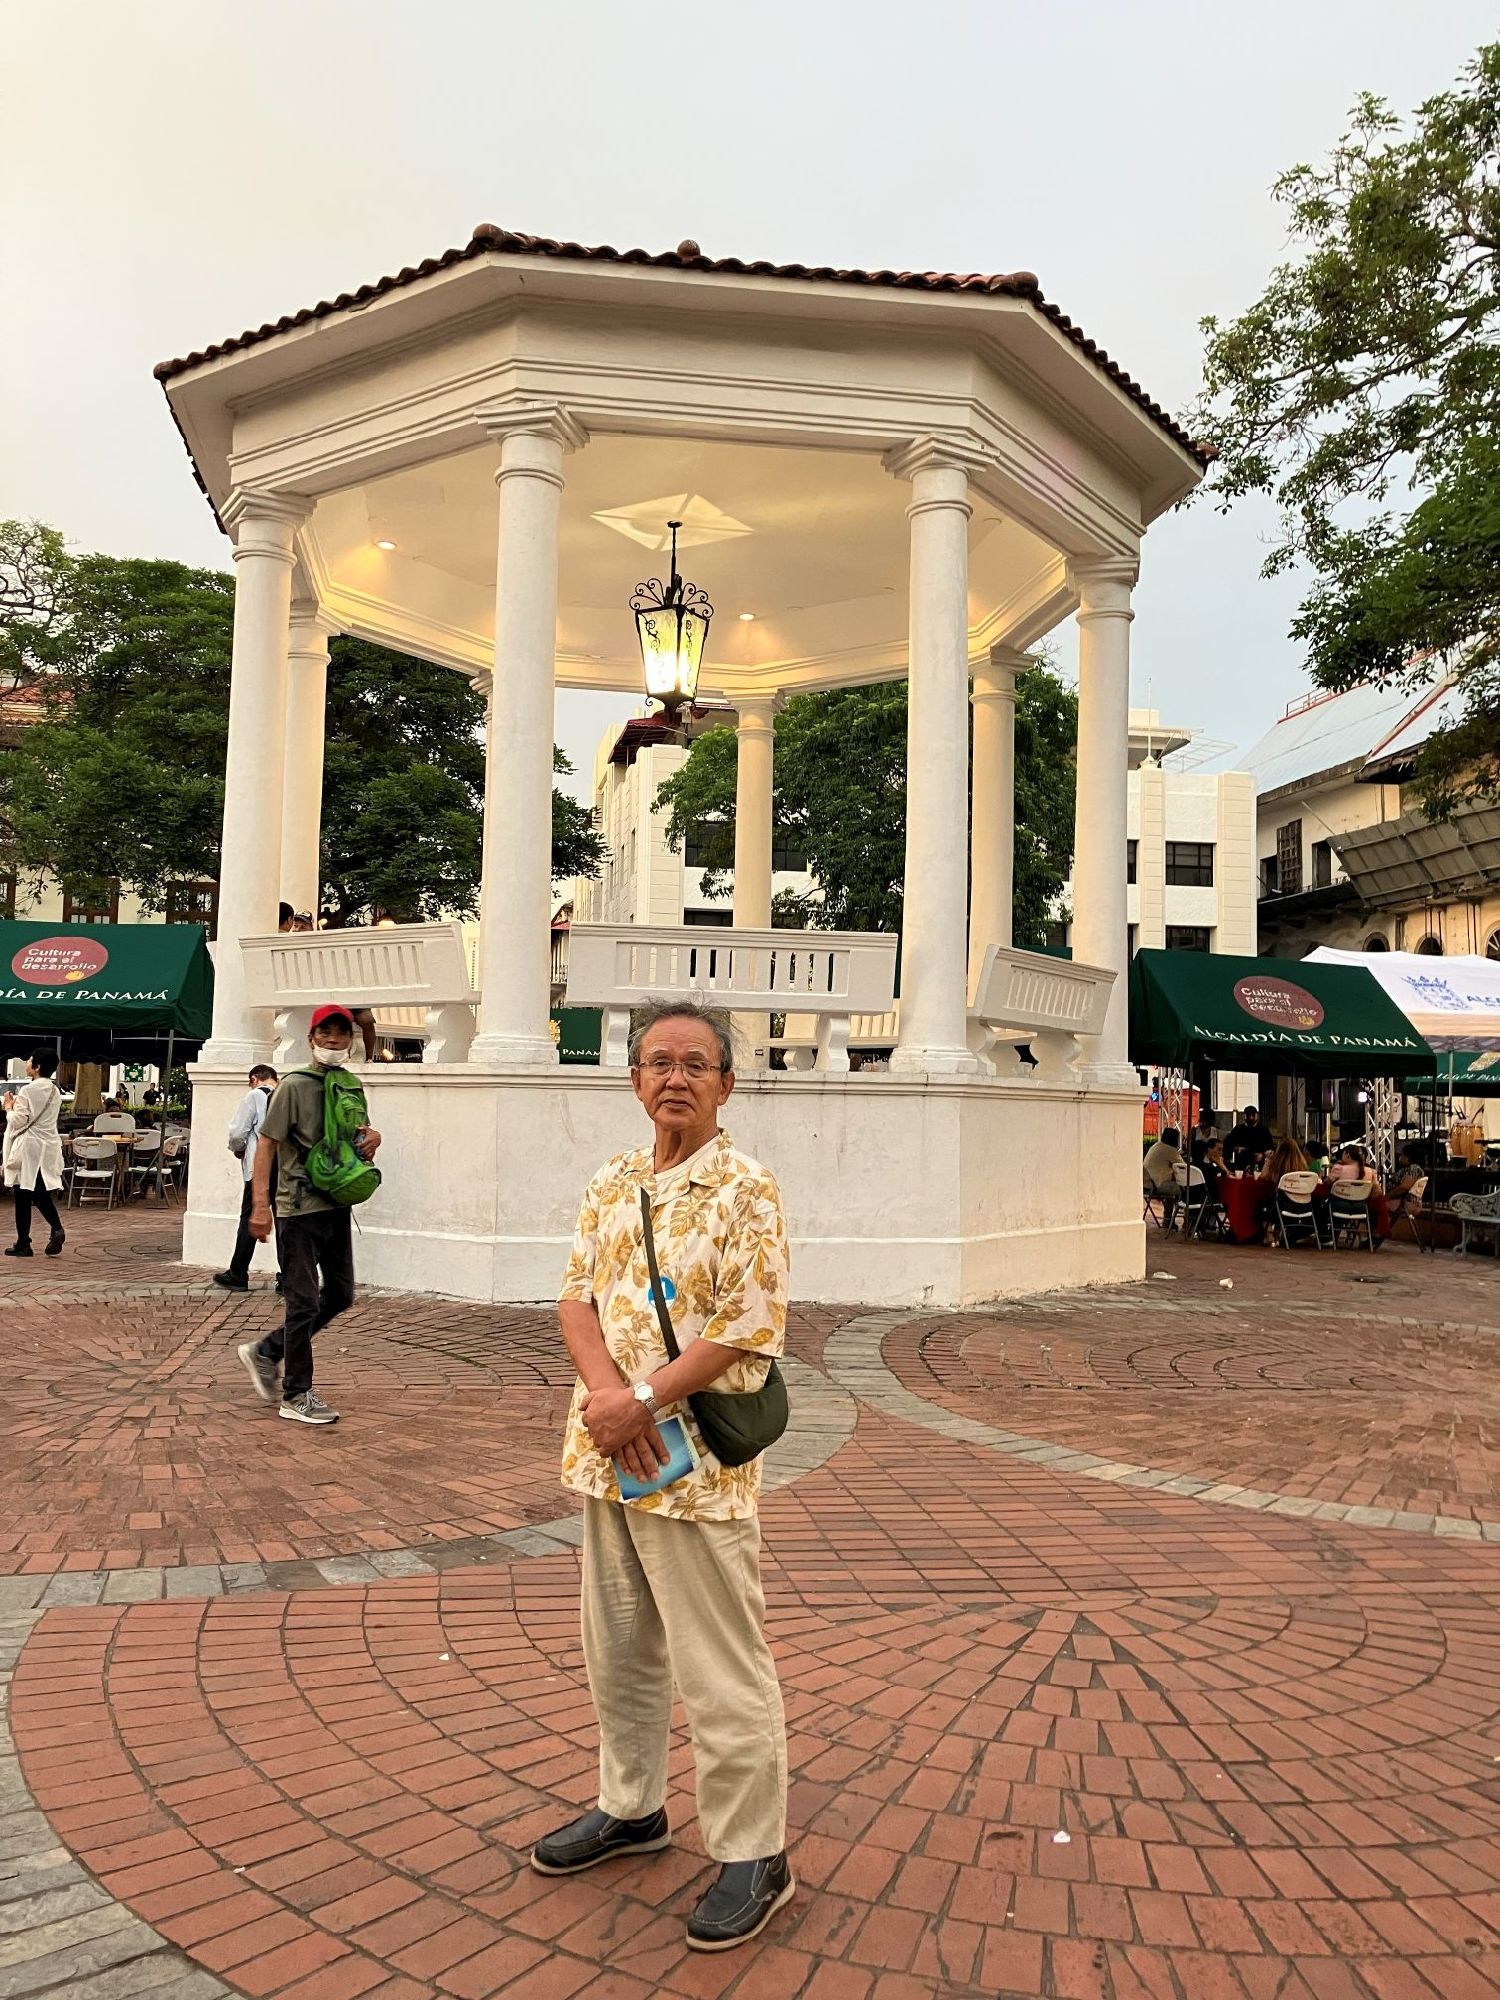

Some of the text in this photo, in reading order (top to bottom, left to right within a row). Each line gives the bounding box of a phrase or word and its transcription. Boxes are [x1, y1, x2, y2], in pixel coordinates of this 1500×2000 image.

[28, 948, 81, 957] Cultura
[24, 956, 75, 964] para el
[21, 962, 97, 970] desarrollo
[36, 990, 67, 999] DE
[74, 989, 169, 1000] PANAMÁ
[1240, 987, 1290, 999] Cultura
[1194, 1025, 1418, 1049] ALCALDÍA DE PANAMÁ
